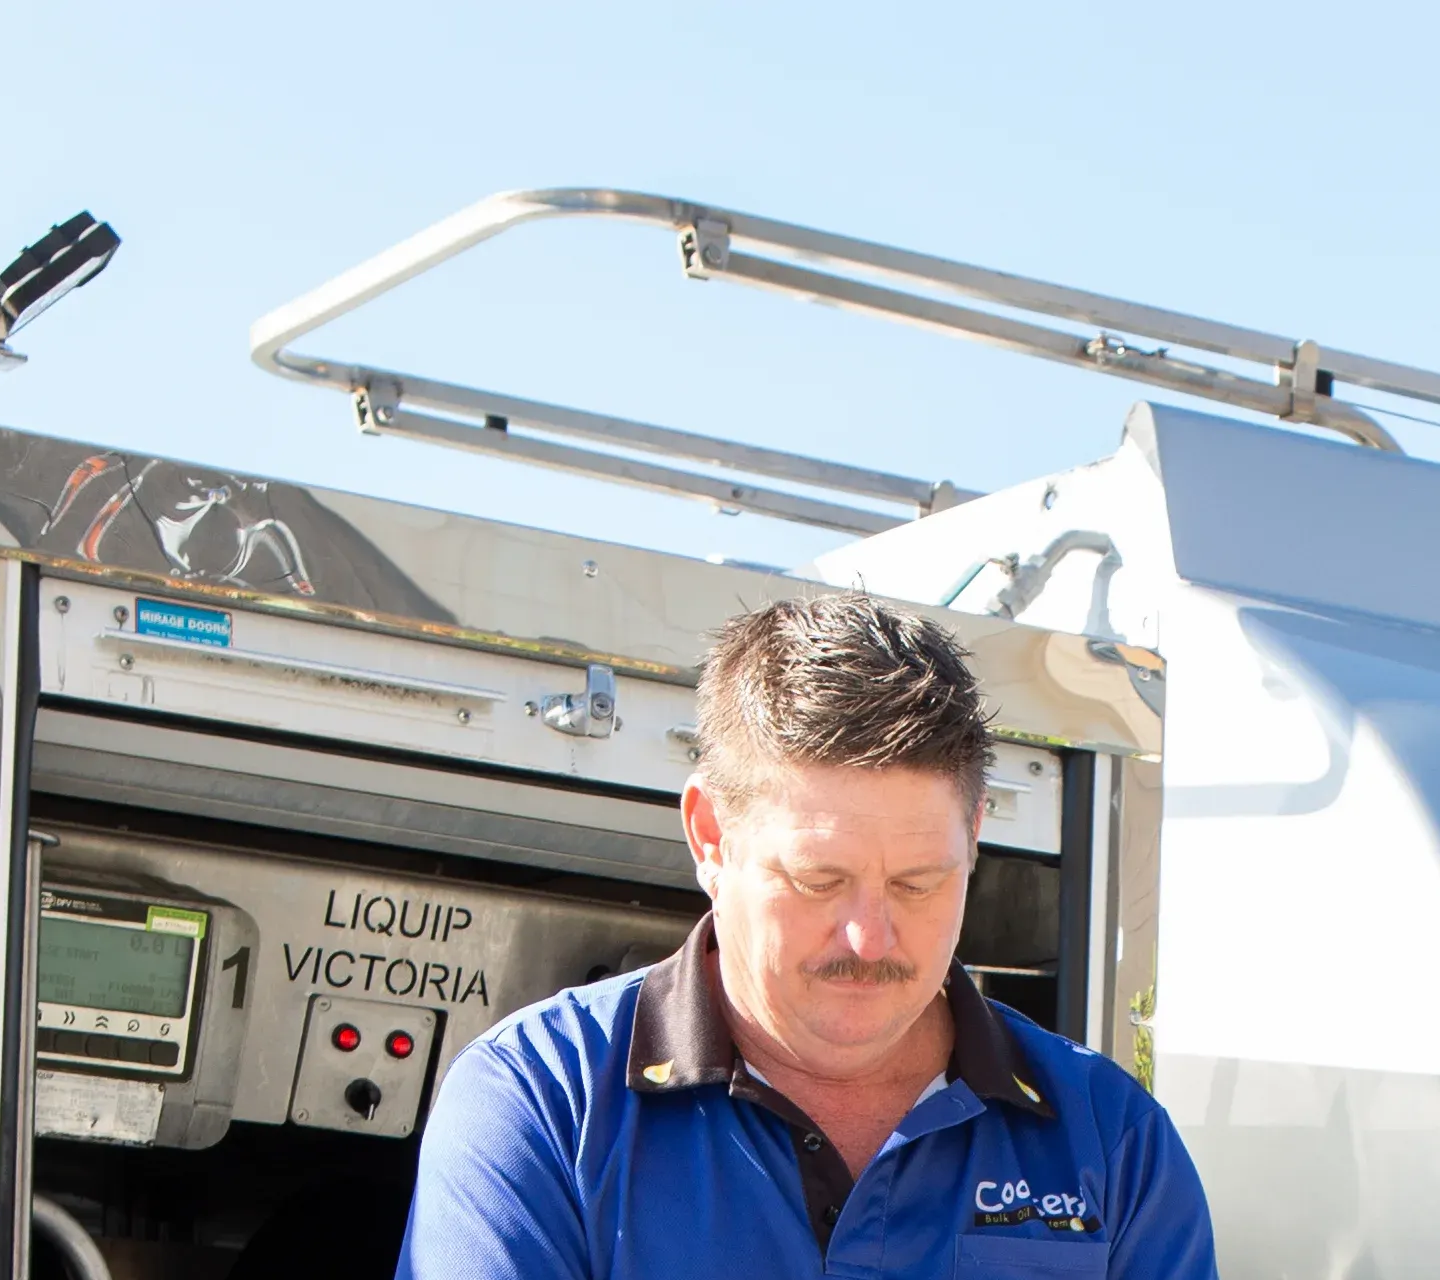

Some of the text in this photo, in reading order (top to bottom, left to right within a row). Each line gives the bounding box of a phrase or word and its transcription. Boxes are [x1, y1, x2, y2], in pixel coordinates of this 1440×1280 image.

[324, 889, 472, 942] LIQUIP
[221, 945, 252, 1009] 1
[283, 943, 489, 1006] VICTORIA
[985, 1214, 1010, 1224] Bulk
